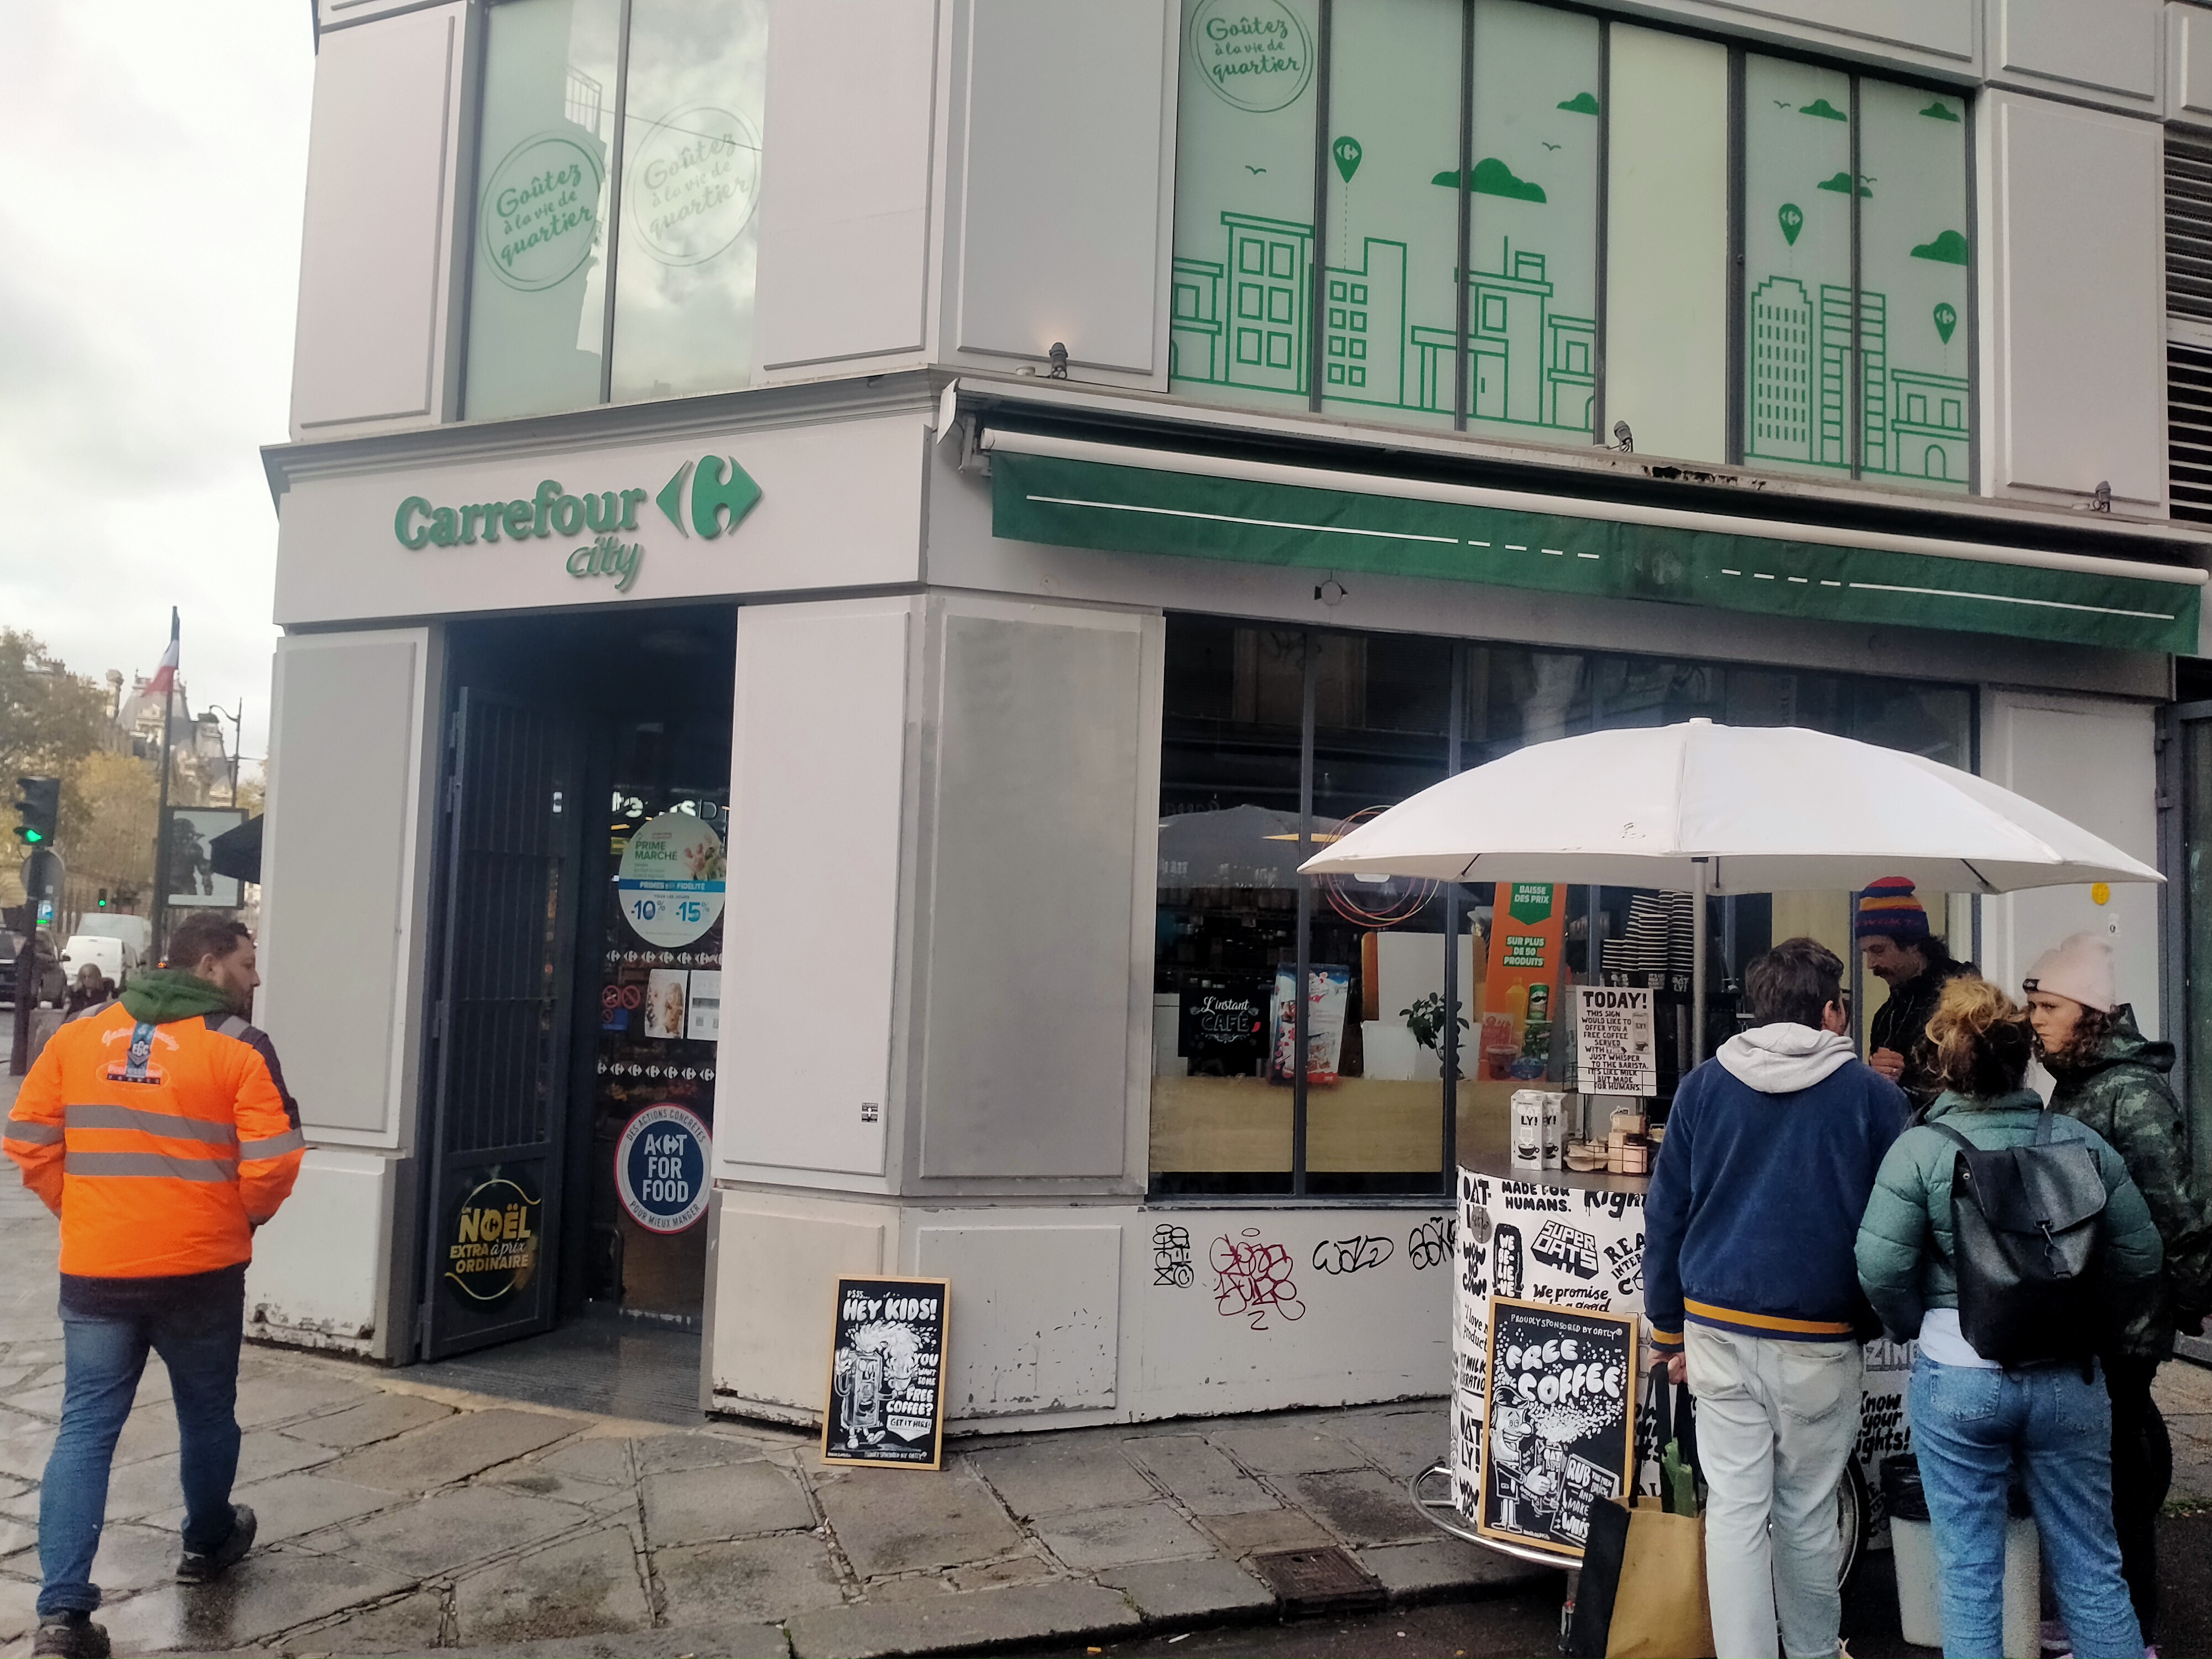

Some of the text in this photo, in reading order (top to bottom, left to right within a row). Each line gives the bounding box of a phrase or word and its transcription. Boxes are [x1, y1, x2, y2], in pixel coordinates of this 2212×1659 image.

[1206, 17, 1288, 41] Goûtez
[1244, 43, 1264, 53] vie
[1267, 38, 1285, 51] de
[1213, 54, 1300, 84] quartier
[643, 133, 736, 189] Goûtez
[497, 164, 581, 217] Goûtez
[534, 202, 556, 220] vie
[559, 190, 577, 206] de
[649, 176, 748, 241] quartier
[500, 206, 592, 267] quartier
[394, 479, 647, 550] Carrefour
[566, 535, 645, 592] city
[635, 841, 666, 850] PRIME
[1514, 894, 1549, 904] DES PRIX
[1519, 885, 1546, 895] BAISSE
[1507, 936, 1545, 947] SUR PLUS
[1513, 947, 1536, 956] DE 50
[1582, 991, 1647, 1009] TODAY!
[626, 1125, 639, 1141] DES
[639, 1109, 667, 1126] ACTIONS
[1521, 1115, 1537, 1126] LY!
[648, 1156, 682, 1179] FOR
[642, 1180, 688, 1203] FOOD
[1501, 1181, 1537, 1196] MADE
[629, 1201, 701, 1228] POUR MIEUX MANGER
[1505, 1196, 1572, 1213] HUMANS.
[458, 1203, 531, 1243] NOËL
[450, 1243, 489, 1259] EXTRA
[499, 1238, 525, 1260] prix
[1499, 1233, 1515, 1251] WE
[455, 1254, 529, 1274] ORDINAIRE
[1531, 1234, 1599, 1274] OATS
[1533, 1284, 1553, 1298] We
[1555, 1286, 1609, 1303] promise
[843, 1298, 938, 1321] HEY KIDS!
[1511, 1313, 1617, 1340] PROUDLY SPONSORED BY OATLY
[913, 1354, 940, 1366] YOU
[1465, 1355, 1486, 1375] MILK
[1505, 1339, 1578, 1371] FREE
[917, 1376, 936, 1386] SOME
[918, 1368, 936, 1377] WANT
[1517, 1362, 1621, 1405] COFFEE
[906, 1388, 935, 1402] FREE
[886, 1401, 934, 1416] COFFEE?
[890, 1418, 903, 1427] GET
[913, 1421, 931, 1430] HERE!
[1862, 1411, 1903, 1437] your
[1462, 1439, 1480, 1473] LY!
[1566, 1459, 1591, 1487] RUB
[1567, 1498, 1590, 1516] MAKE
[1578, 1489, 1594, 1503] AND
